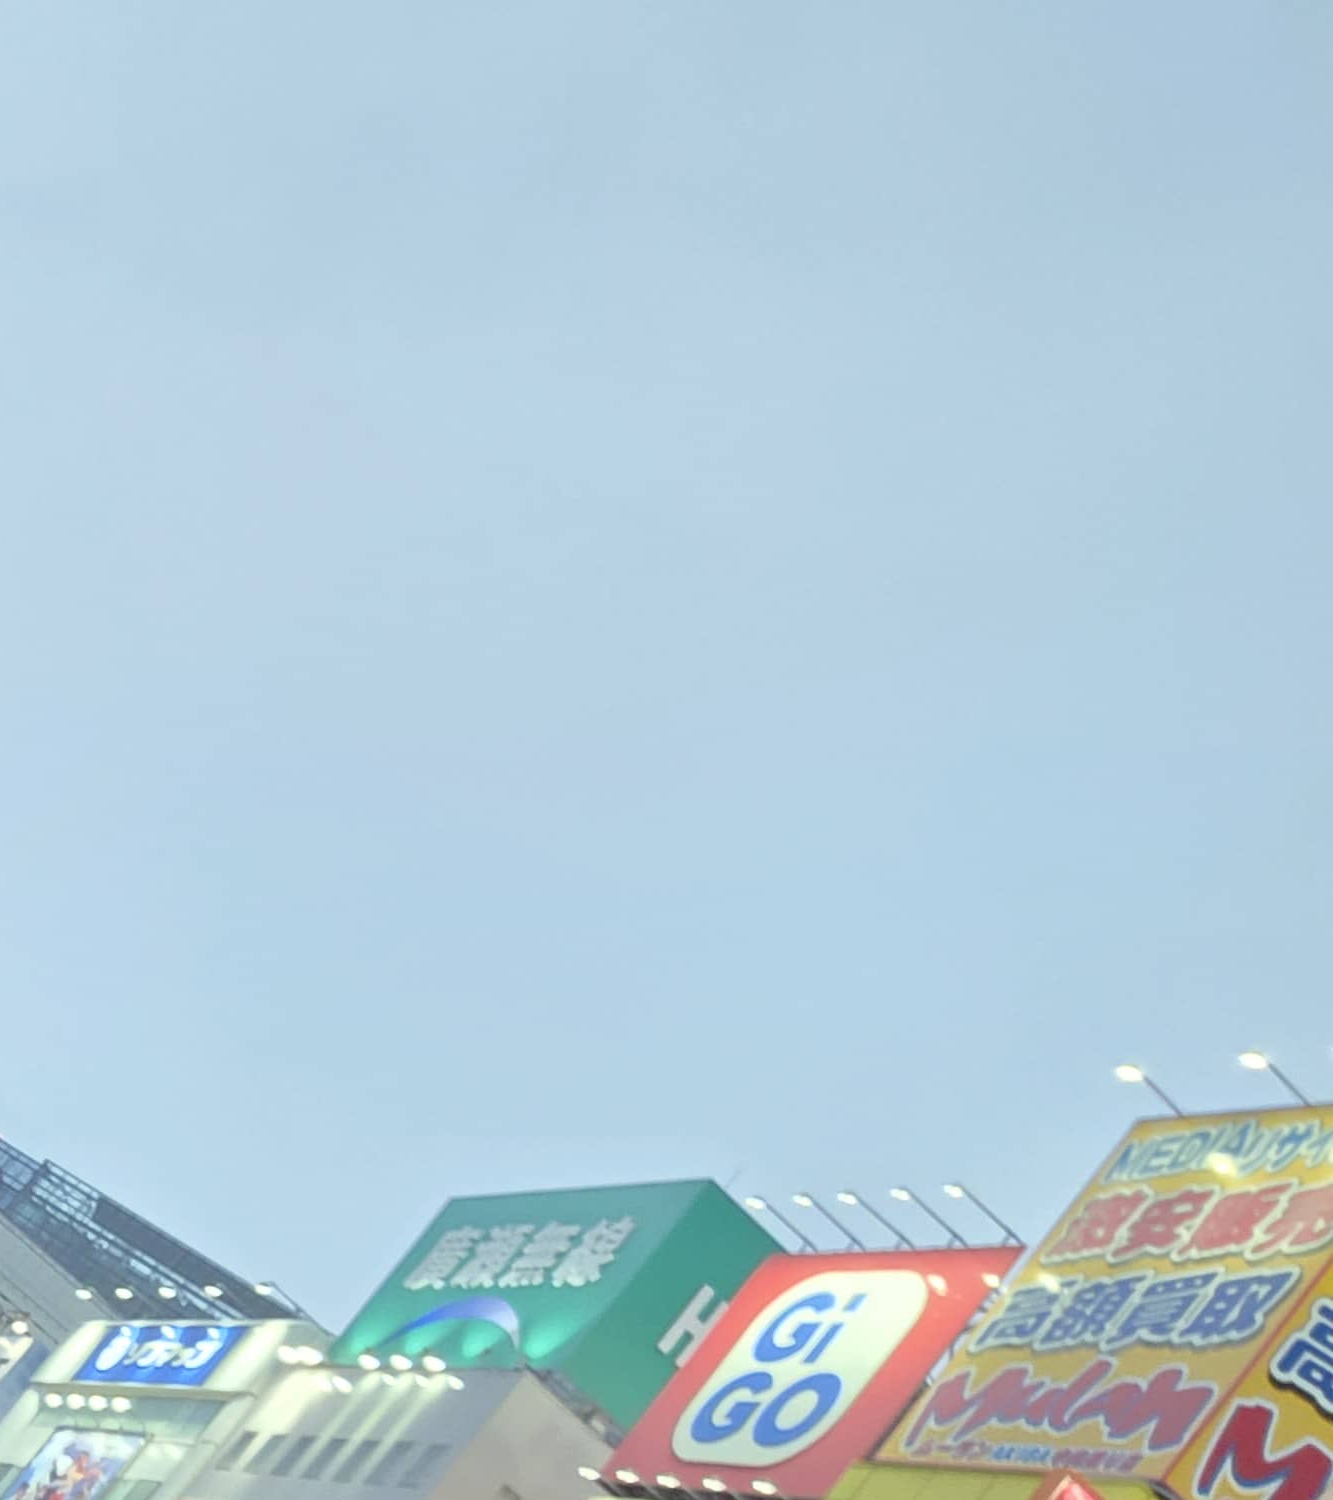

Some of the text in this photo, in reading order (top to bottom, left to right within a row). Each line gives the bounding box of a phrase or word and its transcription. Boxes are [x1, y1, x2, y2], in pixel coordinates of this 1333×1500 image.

[967, 1266, 1301, 1355] 高額買取
[688, 1370, 843, 1449] GO
